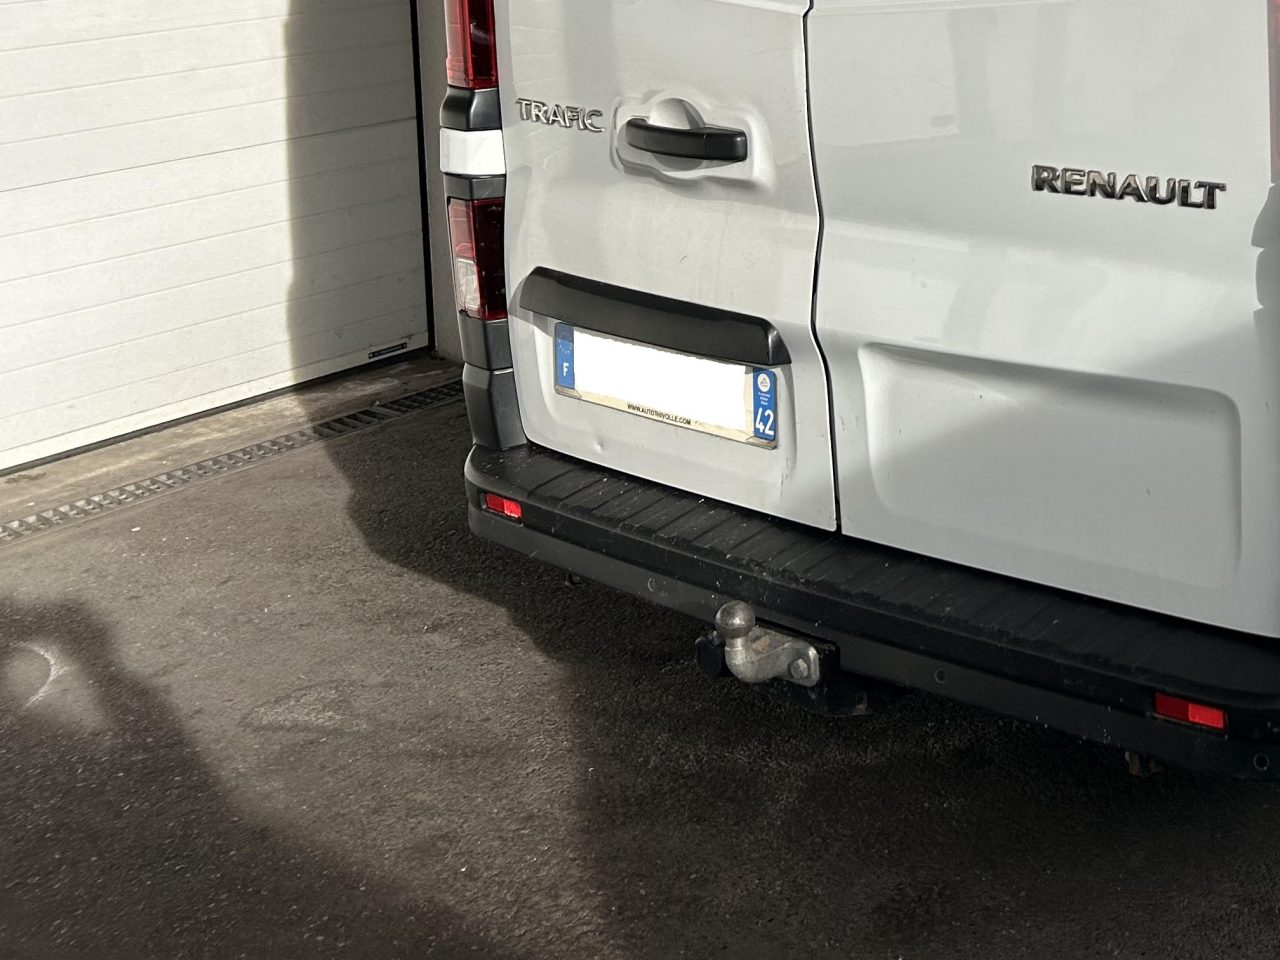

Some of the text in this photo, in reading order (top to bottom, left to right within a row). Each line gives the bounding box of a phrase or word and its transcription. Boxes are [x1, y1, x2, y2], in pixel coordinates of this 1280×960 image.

[516, 97, 605, 133] TRAFIC
[1031, 164, 1227, 209] RENAULT
[563, 362, 569, 376] F
[755, 407, 775, 436] 42
